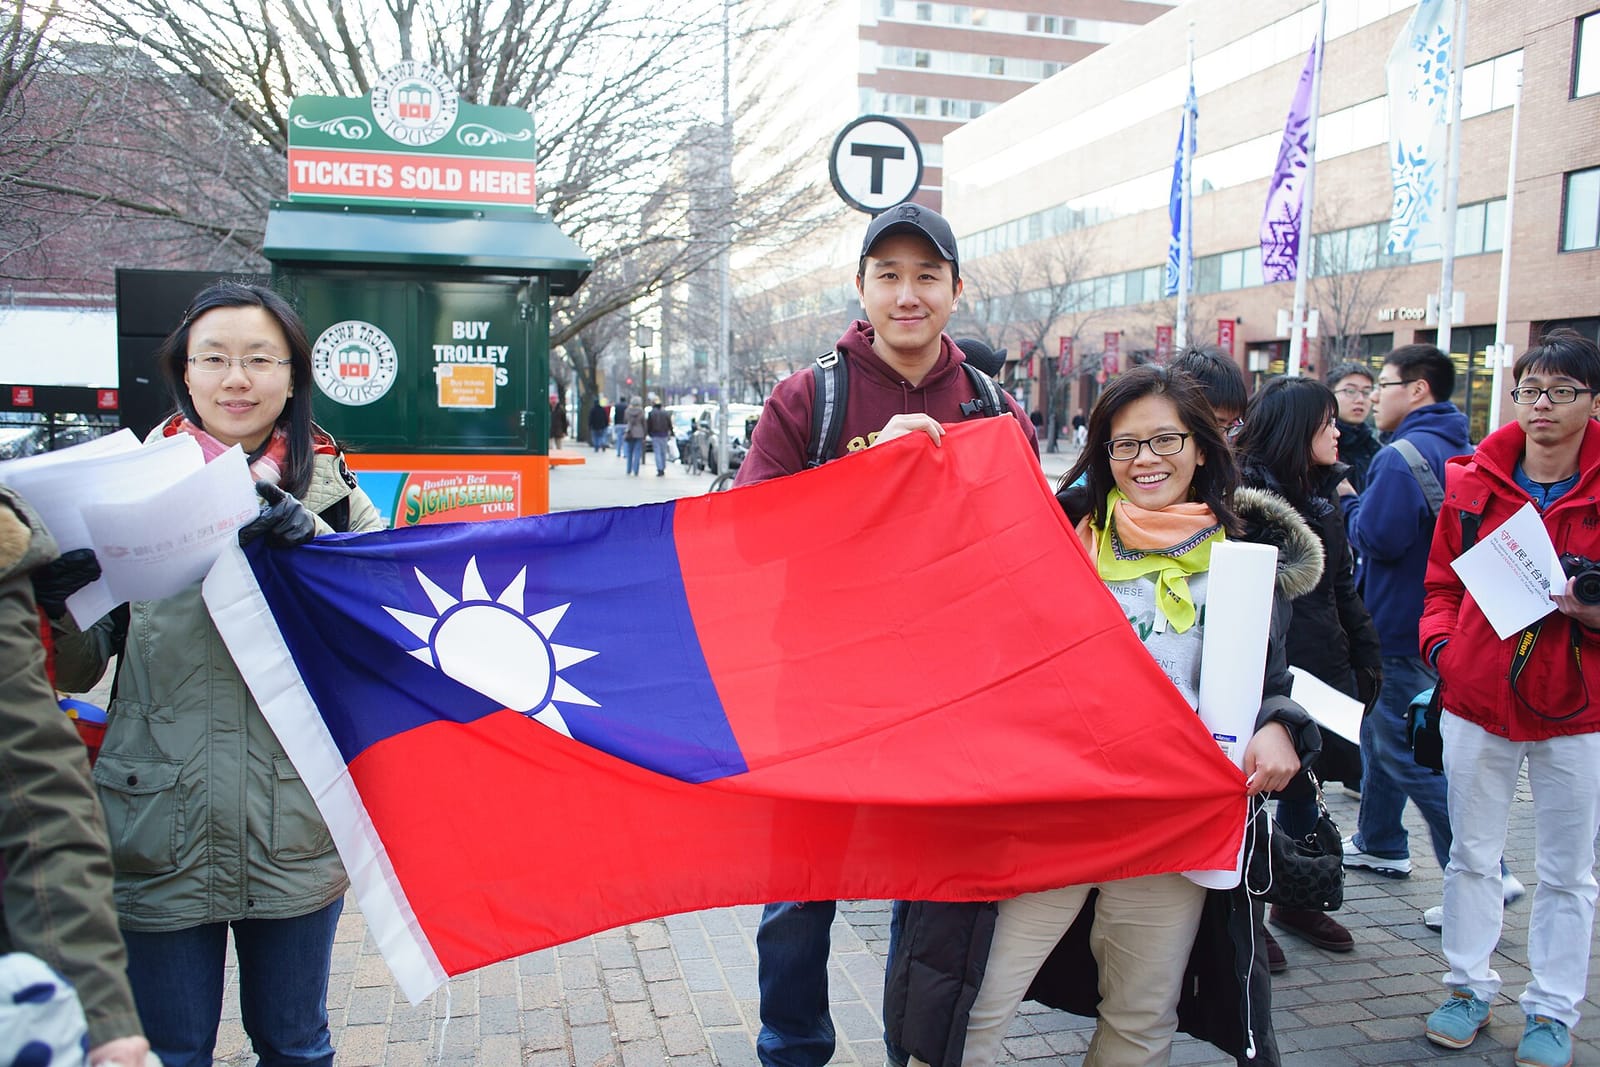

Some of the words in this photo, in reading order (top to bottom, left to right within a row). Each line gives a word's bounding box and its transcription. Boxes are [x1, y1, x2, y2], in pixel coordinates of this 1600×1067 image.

[385, 115, 447, 145] TOURS
[293, 160, 394, 188] TICKETS
[400, 166, 462, 192] SOLD
[469, 170, 532, 195] HERE
[851, 143, 904, 194] T
[1378, 308, 1395, 321] MIT
[1398, 306, 1426, 321] Coop
[322, 325, 355, 348] TOWN
[452, 320, 491, 340] BUY
[316, 348, 330, 369] OLD
[360, 326, 394, 373] TROLLEY
[432, 344, 509, 363] TROLLEY
[325, 375, 385, 402] TOURS
[423, 475, 463, 490] Boston's
[466, 474, 488, 485] Best
[405, 484, 514, 526] SIGHTSEEING
[481, 502, 515, 514] TOUR
[1501, 530, 1551, 590] 守護民主台灣
[1107, 584, 1144, 598] INESE
[1519, 631, 1534, 656] Nikon
